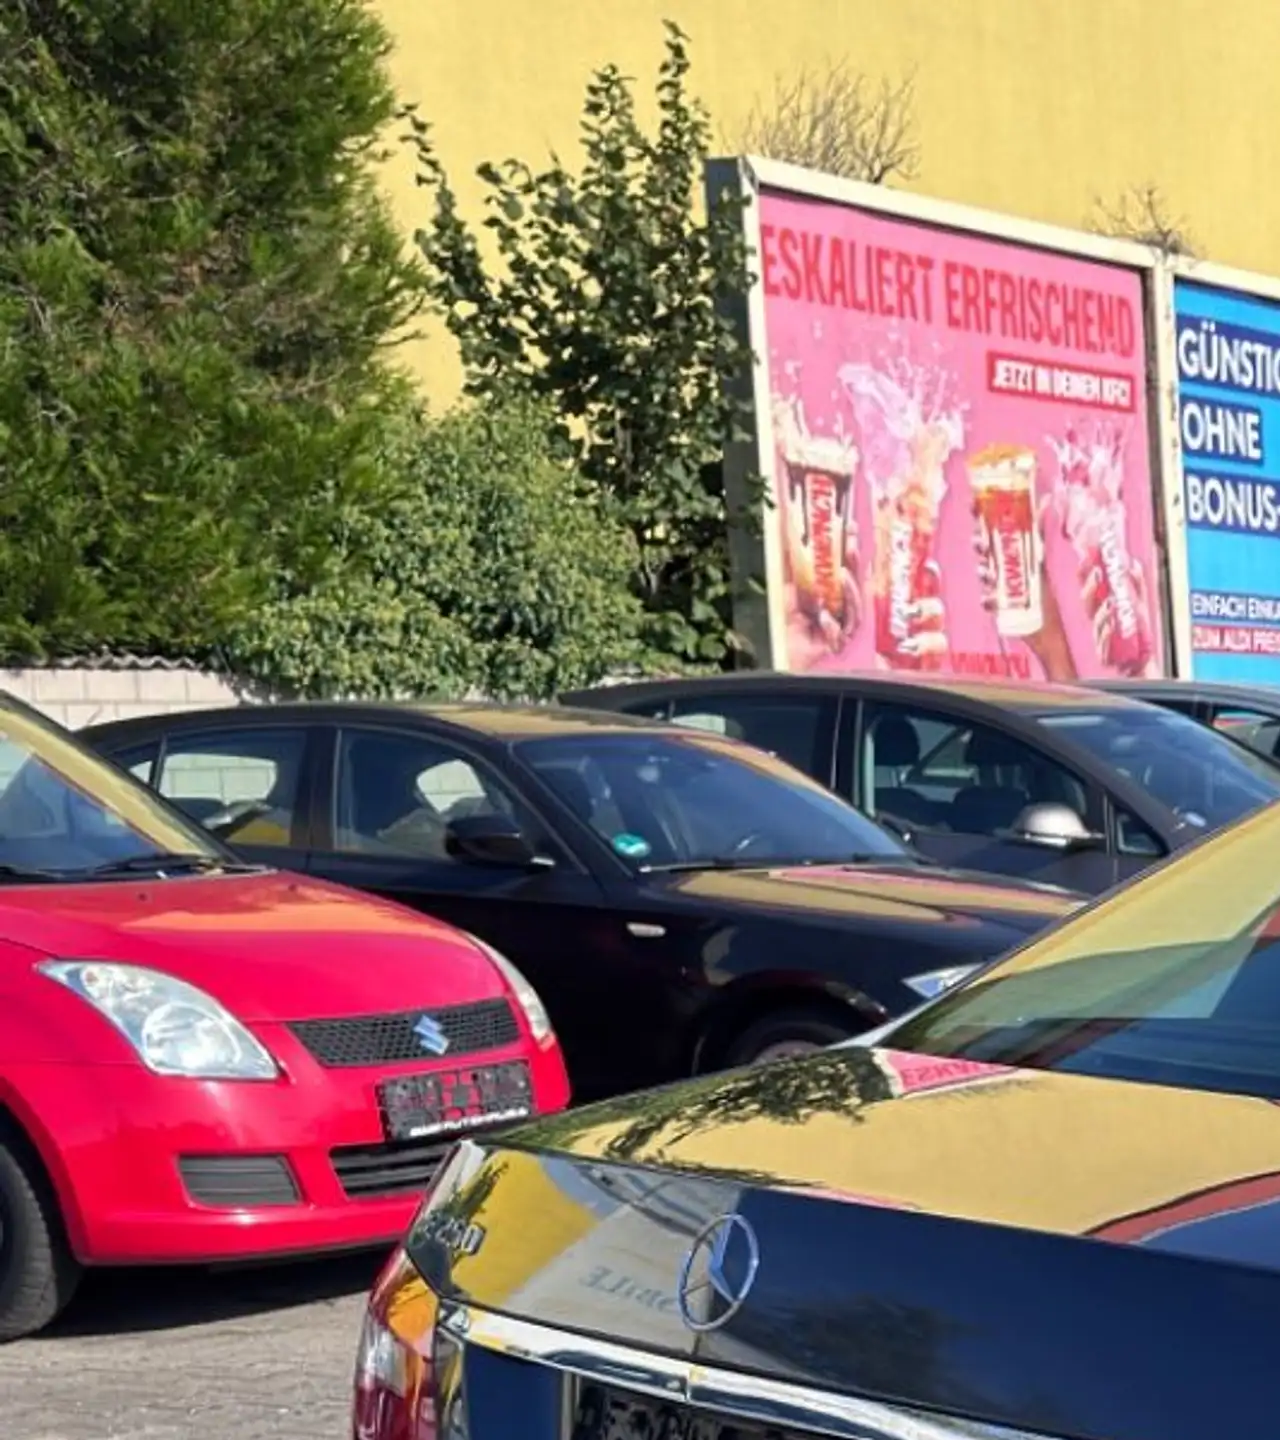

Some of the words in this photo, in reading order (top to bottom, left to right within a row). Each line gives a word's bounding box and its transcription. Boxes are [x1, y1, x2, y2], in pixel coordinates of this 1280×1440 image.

[761, 224, 933, 324] ESKALIERT
[944, 260, 1134, 358] ERFRISCHEND
[1182, 402, 1262, 460] OHNE
[1192, 593, 1246, 618] EINFACH
